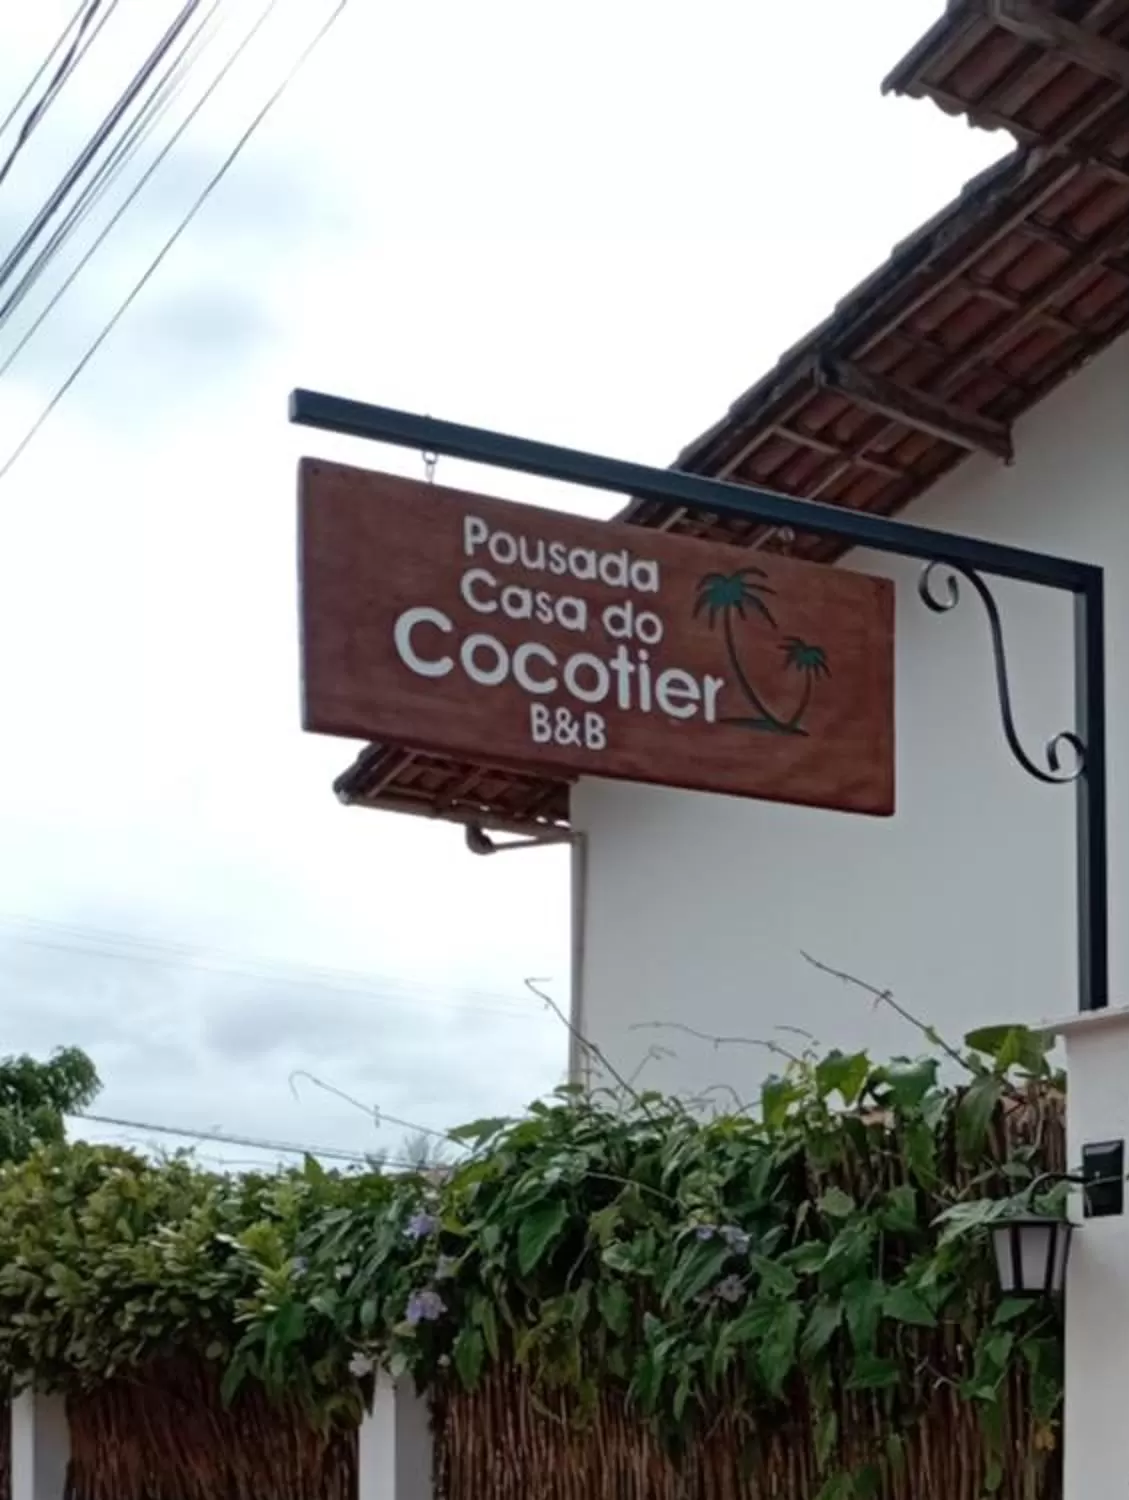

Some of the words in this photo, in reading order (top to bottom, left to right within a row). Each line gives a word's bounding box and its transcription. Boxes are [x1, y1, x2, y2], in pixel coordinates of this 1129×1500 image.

[462, 515, 660, 592] Pousada
[460, 568, 588, 631] Casa
[602, 600, 664, 645] do
[393, 606, 724, 722] Cocotier
[530, 703, 607, 750] B&B
